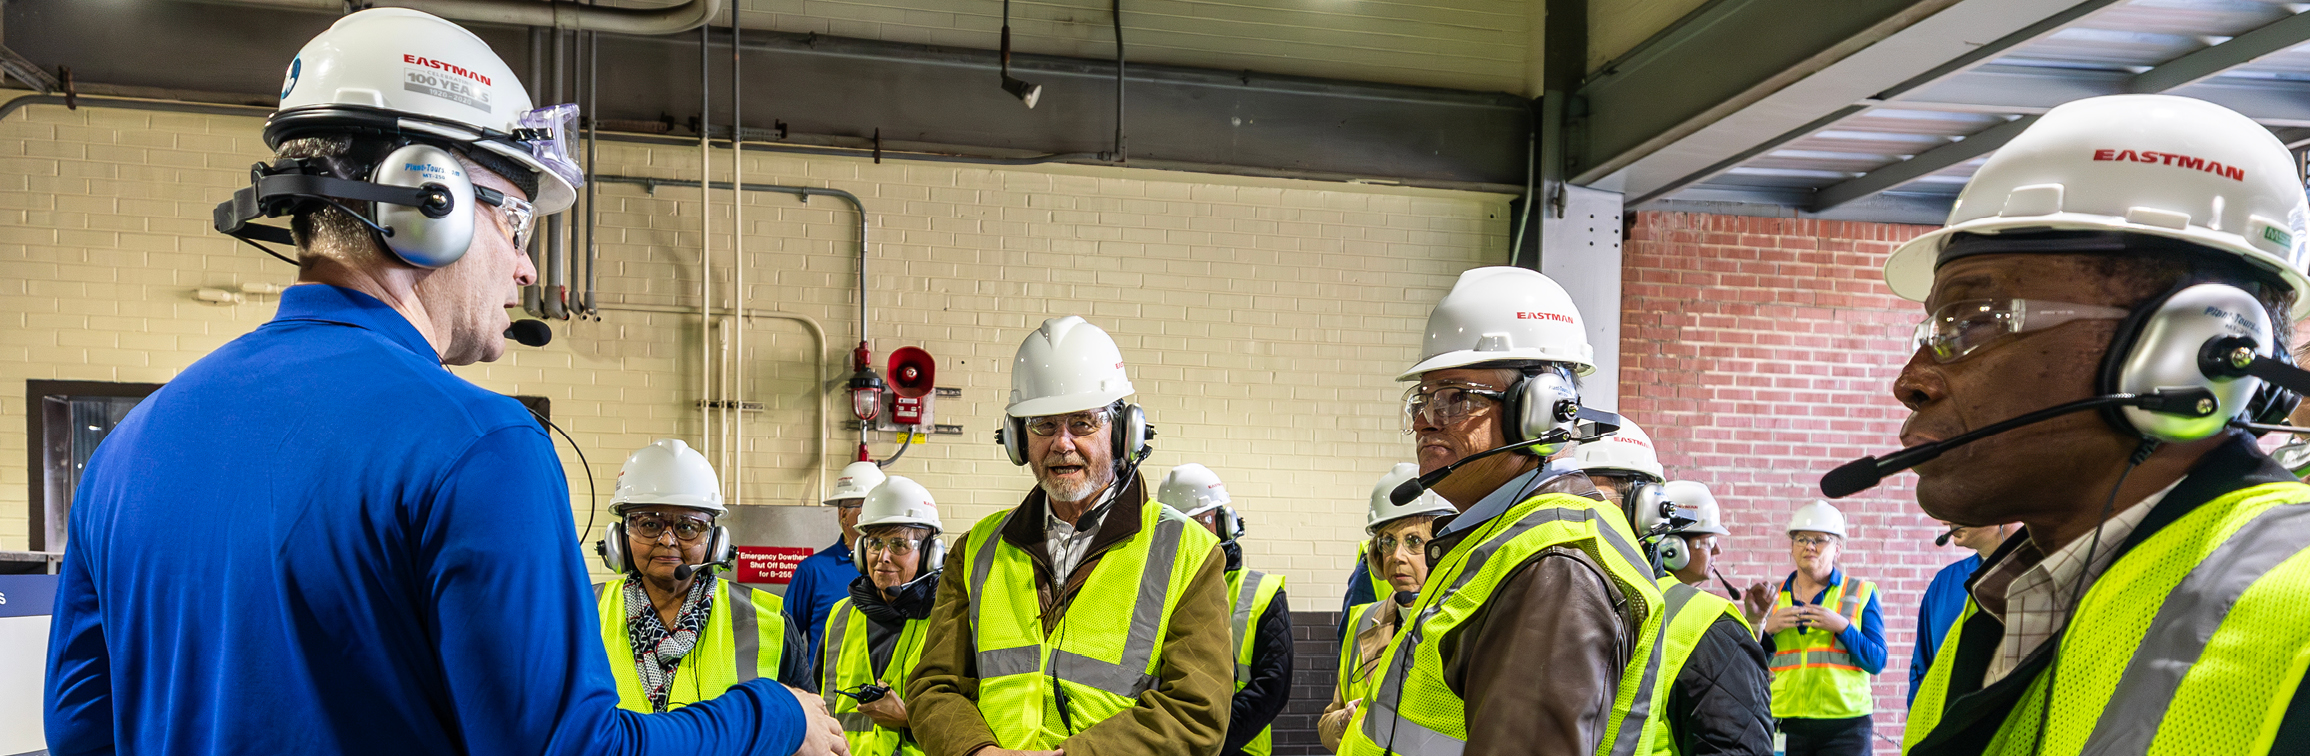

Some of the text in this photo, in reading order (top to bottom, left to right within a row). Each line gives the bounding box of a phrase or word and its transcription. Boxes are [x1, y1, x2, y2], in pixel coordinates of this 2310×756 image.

[403, 53, 491, 86] EASTMAN
[407, 72, 489, 103] 100 YEAS
[2093, 149, 2245, 182] EASTMAN
[2267, 228, 2291, 246] MS
[1516, 312, 1574, 324] EASTMAN
[740, 552, 777, 561] Emergency
[750, 561, 798, 570] Shut Off Butto
